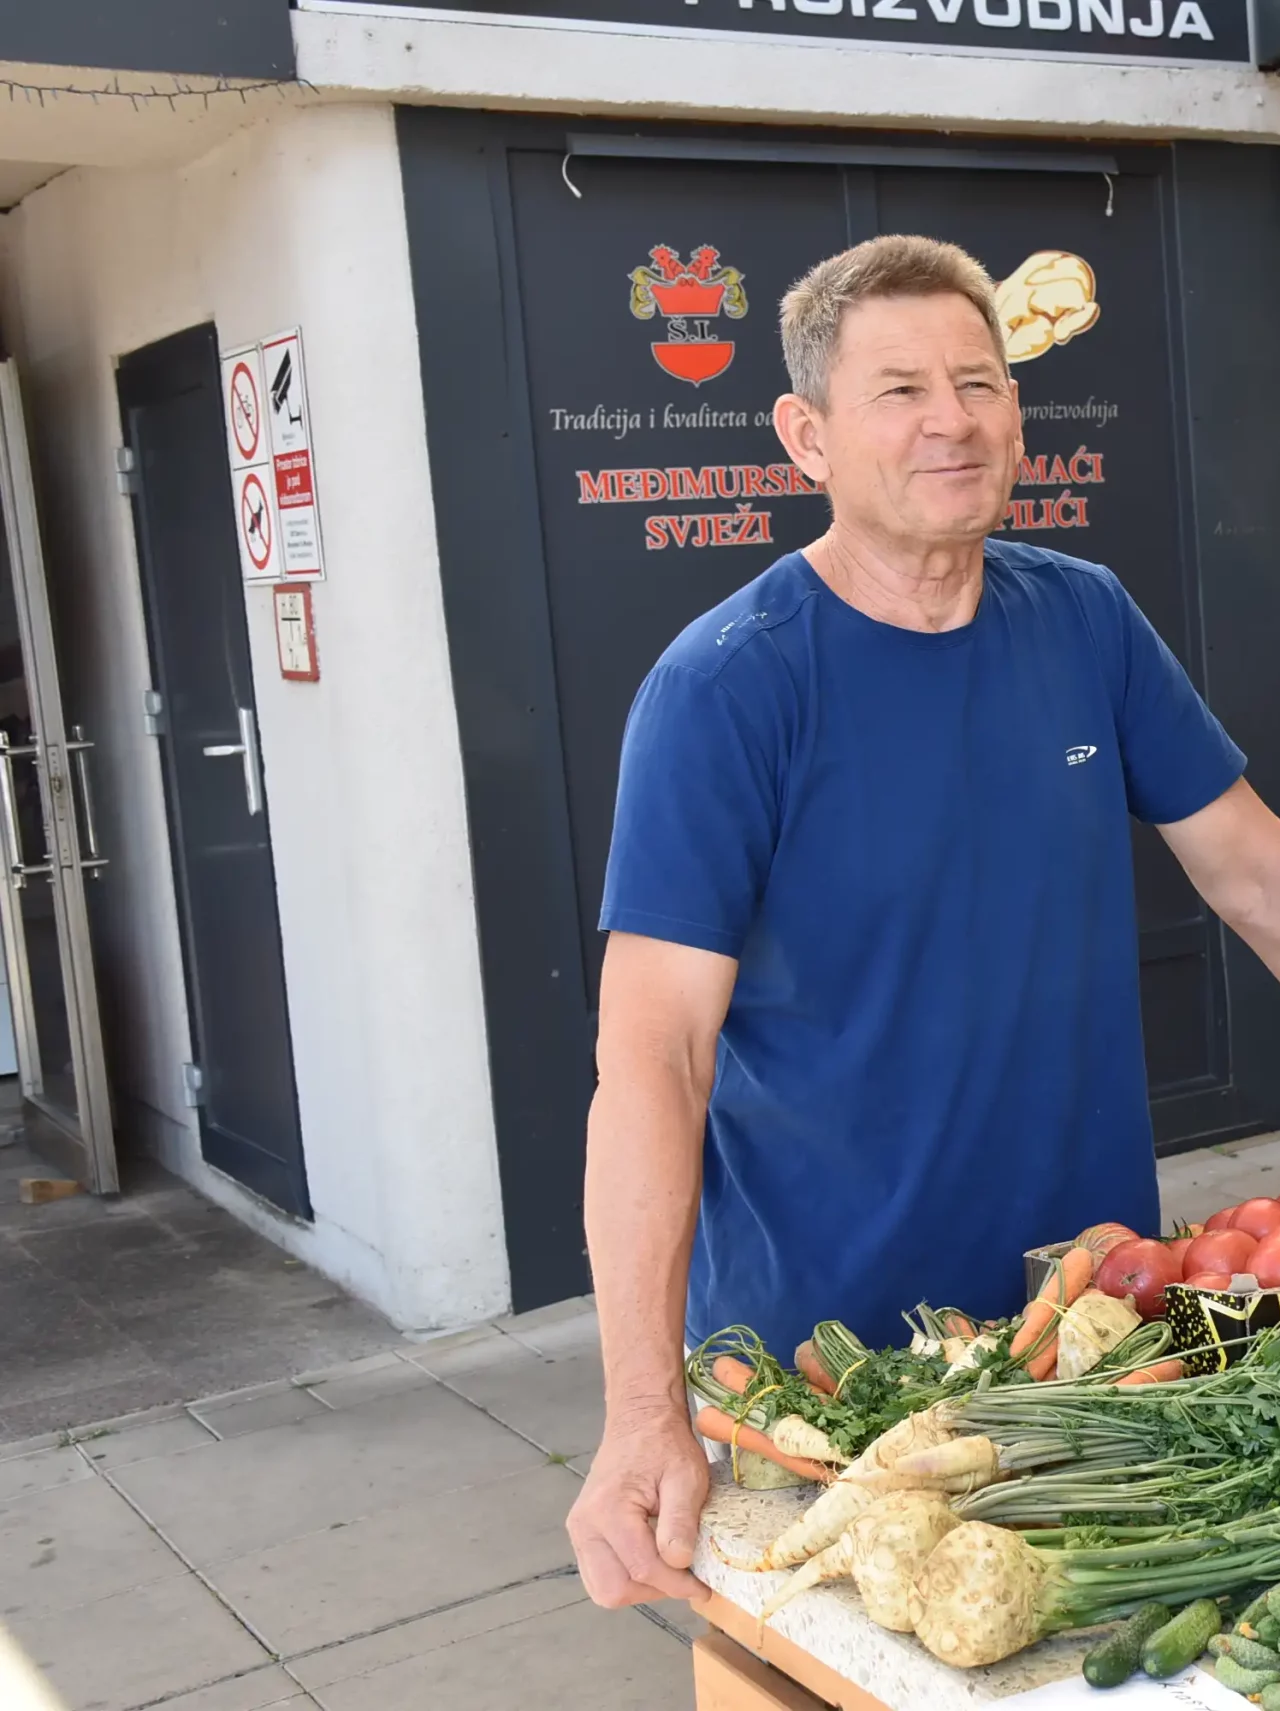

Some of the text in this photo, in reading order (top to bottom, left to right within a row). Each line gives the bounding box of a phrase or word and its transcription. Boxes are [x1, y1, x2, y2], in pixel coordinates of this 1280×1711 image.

[685, 0, 1215, 41] ZVODNJA
[550, 404, 641, 440] Tradicija
[649, 408, 655, 429] i
[663, 403, 747, 429] kvaliteta
[1012, 445, 1105, 485] MAĆI
[645, 503, 774, 550] SVJEŽI
